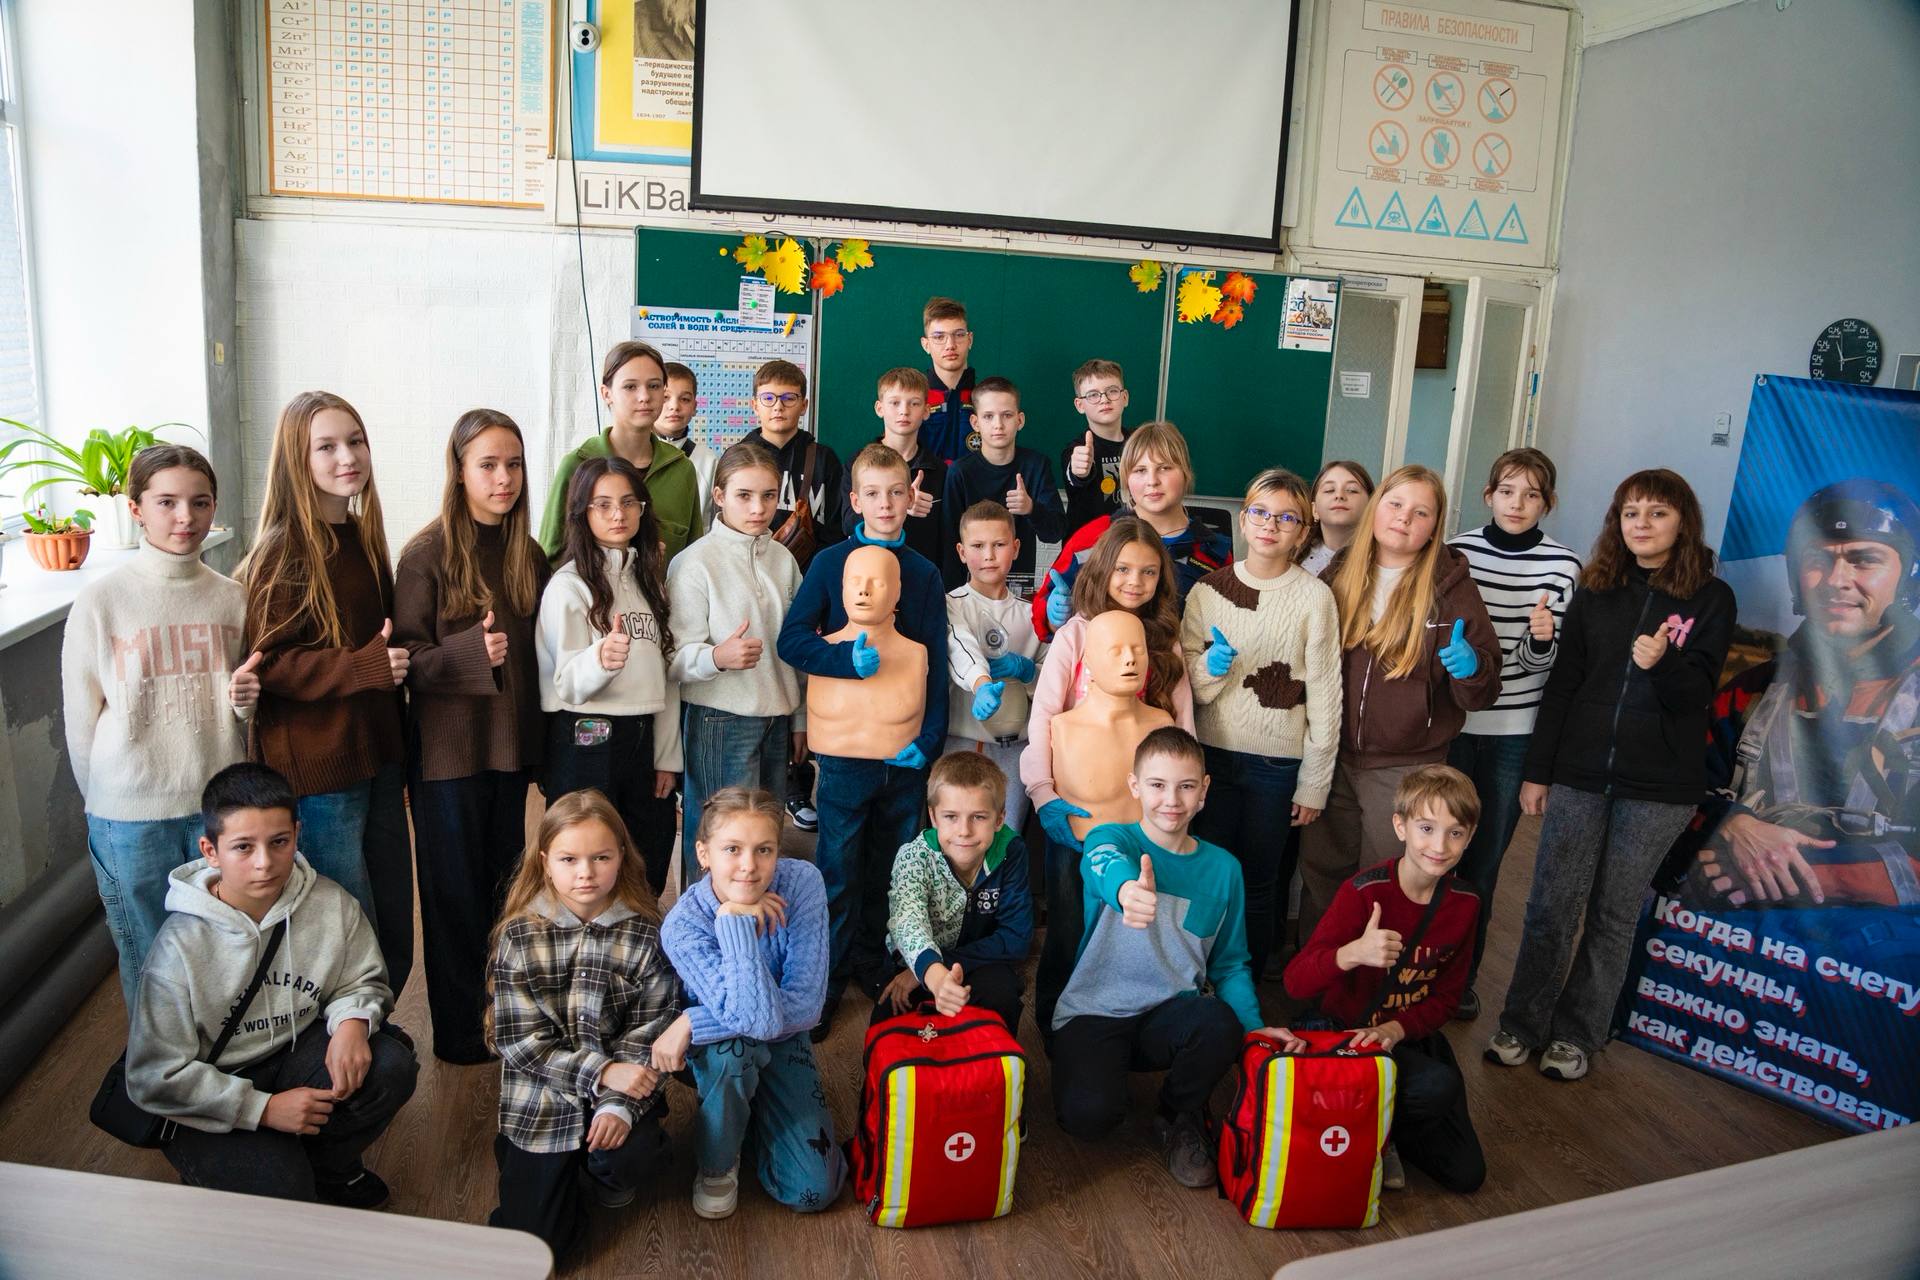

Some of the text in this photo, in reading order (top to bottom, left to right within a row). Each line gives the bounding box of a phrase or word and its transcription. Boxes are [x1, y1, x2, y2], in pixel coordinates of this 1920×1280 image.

[1381, 9, 1520, 45] ПРАВИЛА БЕЗОПАСНОСТИ
[648, 322, 677, 330] СОЛЕЙ
[687, 324, 709, 332] ВОДЕ
[1646, 938, 1804, 1013] секунды,
[1654, 896, 1920, 1012] Когда на счету
[1627, 1011, 1688, 1048] как
[1636, 976, 1868, 1083] важно знать,
